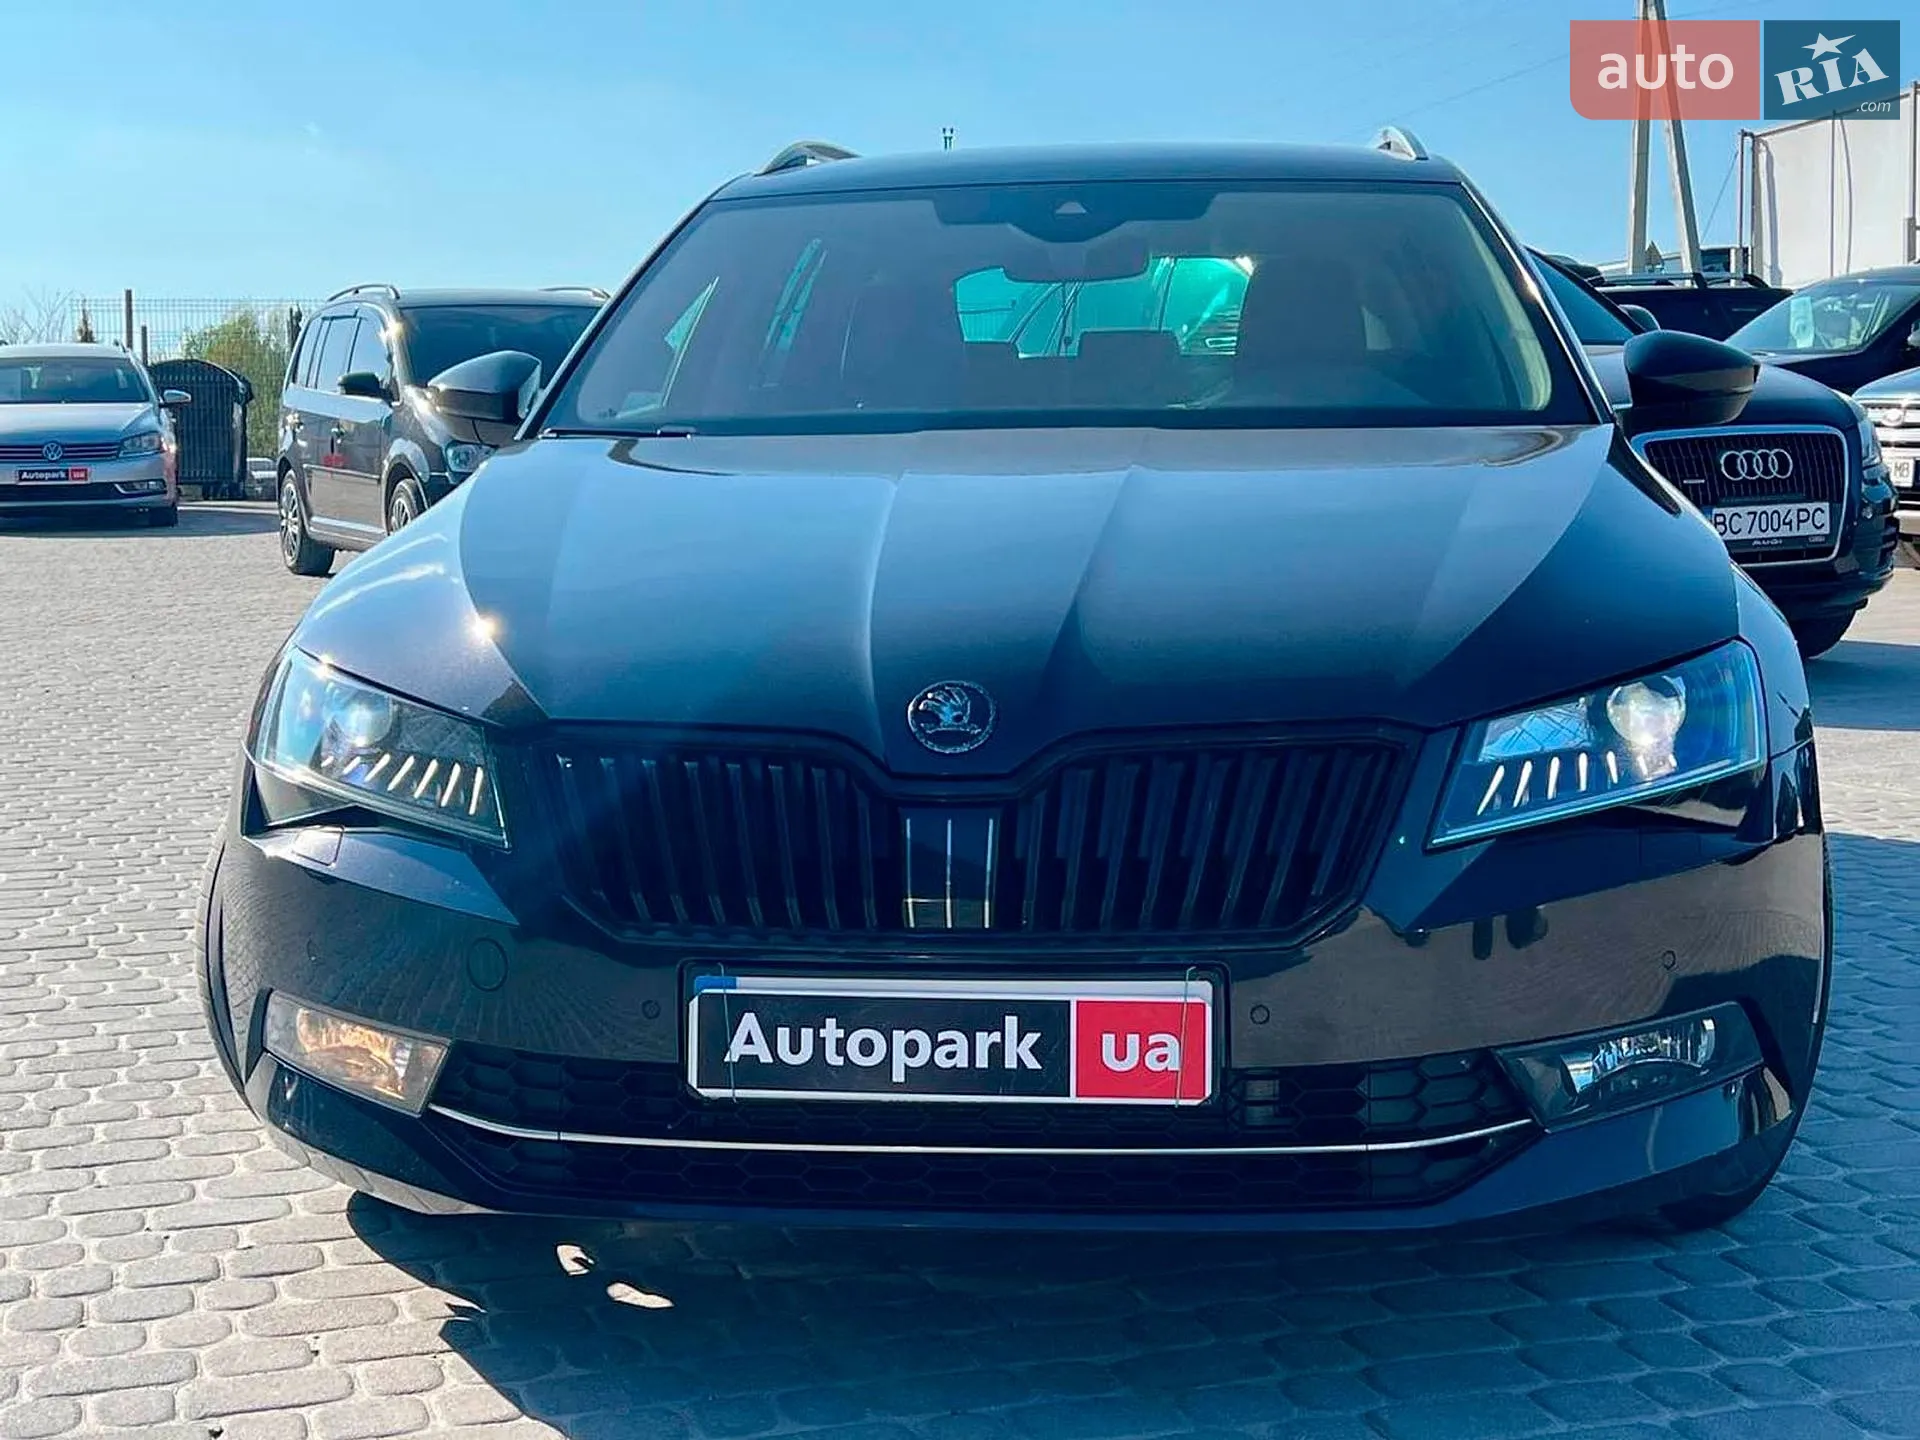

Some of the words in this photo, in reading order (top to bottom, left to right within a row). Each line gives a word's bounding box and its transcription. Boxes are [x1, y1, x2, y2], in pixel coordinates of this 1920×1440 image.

[21, 471, 67, 480] Autopark
[1714, 512, 1743, 536] BC
[1746, 509, 1794, 534] 7004
[1796, 506, 1826, 532] PC
[722, 1011, 1045, 1084] Autopark
[1101, 1031, 1182, 1074] ua
